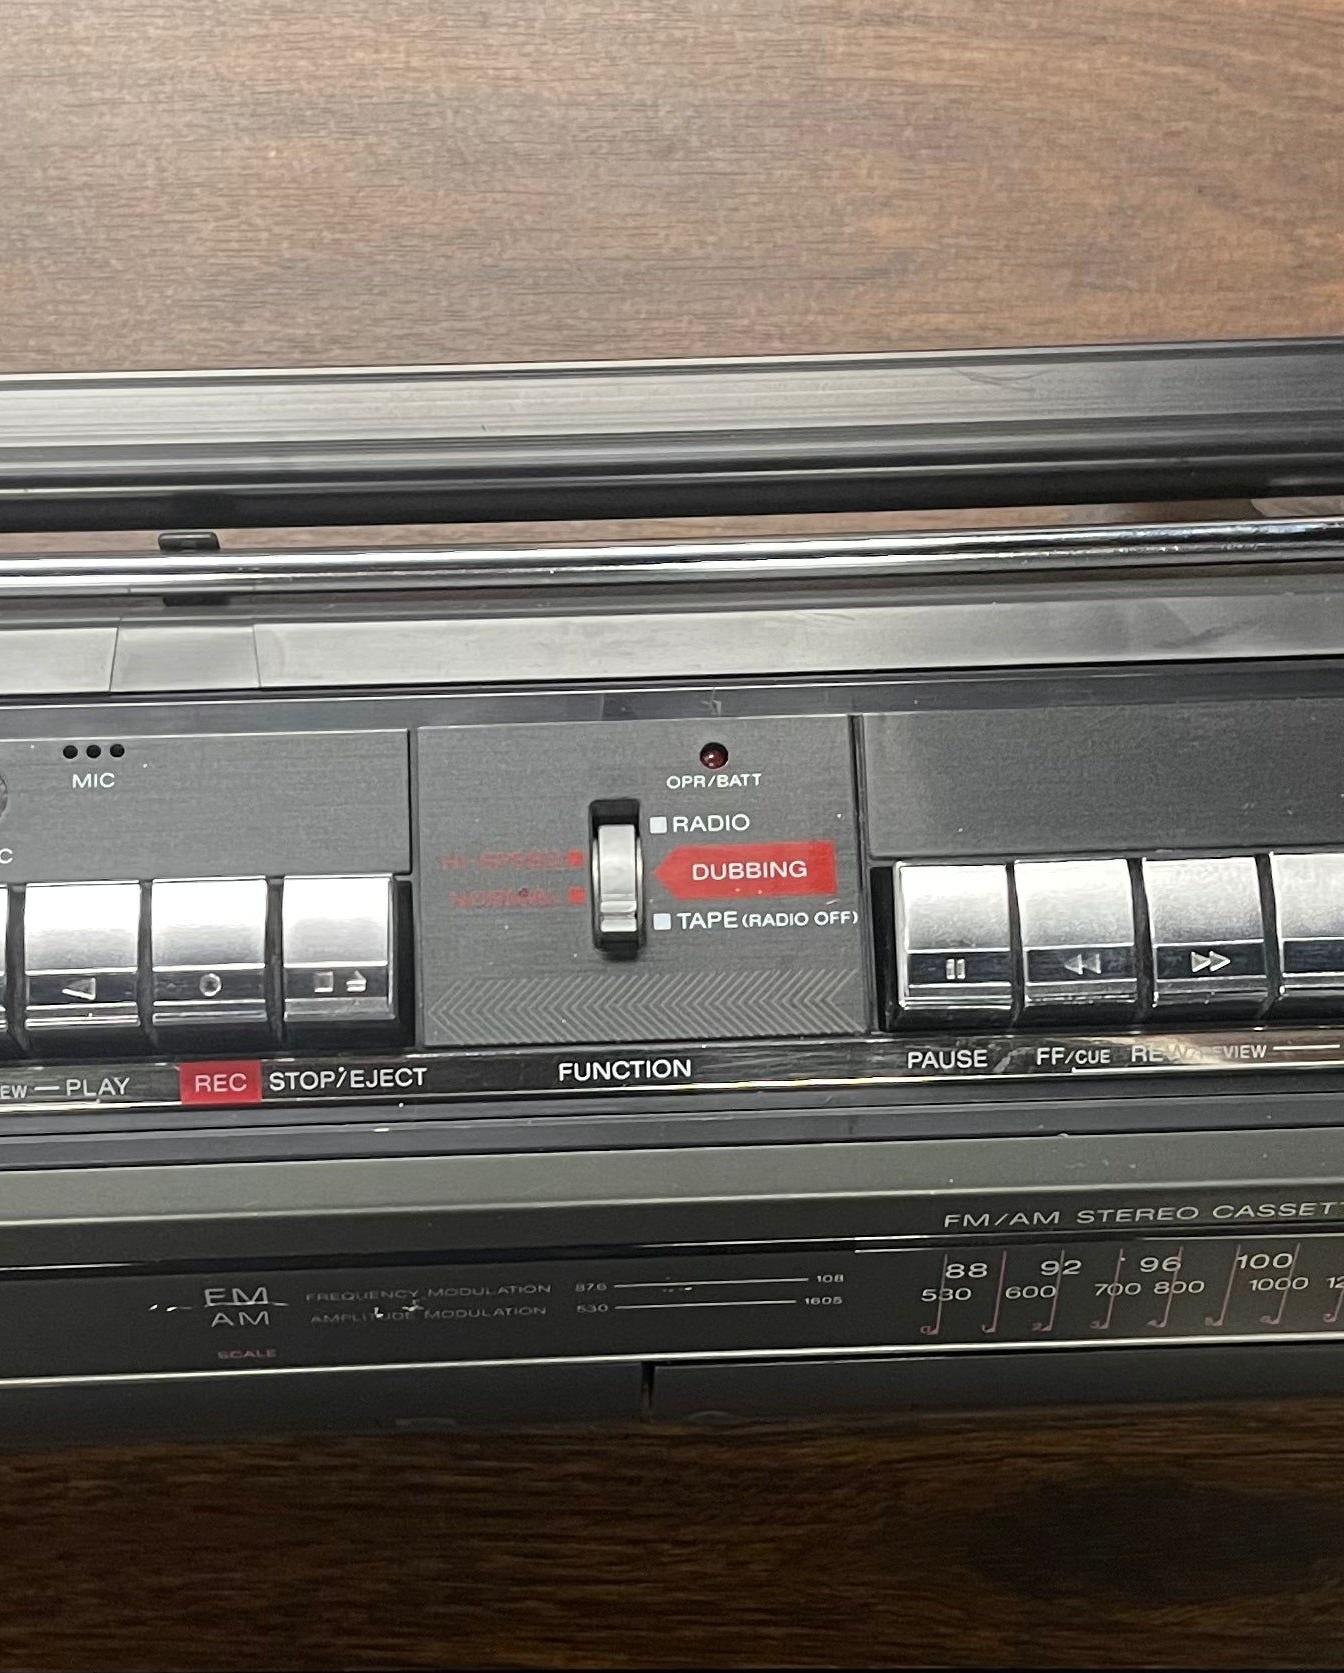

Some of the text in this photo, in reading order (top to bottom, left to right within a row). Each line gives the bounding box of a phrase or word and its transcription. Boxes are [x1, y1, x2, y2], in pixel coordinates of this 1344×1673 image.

[71, 772, 117, 789] MIC
[665, 773, 762, 790] OPR/BATT
[672, 813, 751, 833] RADIO
[691, 860, 808, 881] DUBBING
[676, 910, 859, 929] TAPE (RADIO OFF)
[906, 1049, 988, 1071] PAUSE
[1036, 1047, 1112, 1066] FF/CUE
[268, 1067, 429, 1092] STOP/EJECT
[557, 1058, 693, 1083] FUNCTION
[65, 1076, 132, 1098] PLAY
[194, 1072, 248, 1093] REC
[943, 1211, 1062, 1229] FM/AM
[1075, 1204, 1201, 1225] STEREO
[945, 1262, 988, 1280] 88
[1040, 1259, 1082, 1276] 92
[1139, 1256, 1183, 1273] 96
[1236, 1253, 1294, 1270] 100
[815, 1273, 845, 1284] 108
[306, 1283, 552, 1302] FREQUENCY MODULATION
[920, 1287, 972, 1302] 530
[1005, 1285, 1057, 1300] 600
[1093, 1282, 1142, 1297] 700
[1153, 1280, 1206, 1295] 800
[1249, 1276, 1310, 1292] 1000
[804, 1295, 844, 1306] 1605
[210, 1310, 270, 1328] AM
[423, 1306, 547, 1321] MODULATION
[217, 1349, 277, 1360] SCALE
